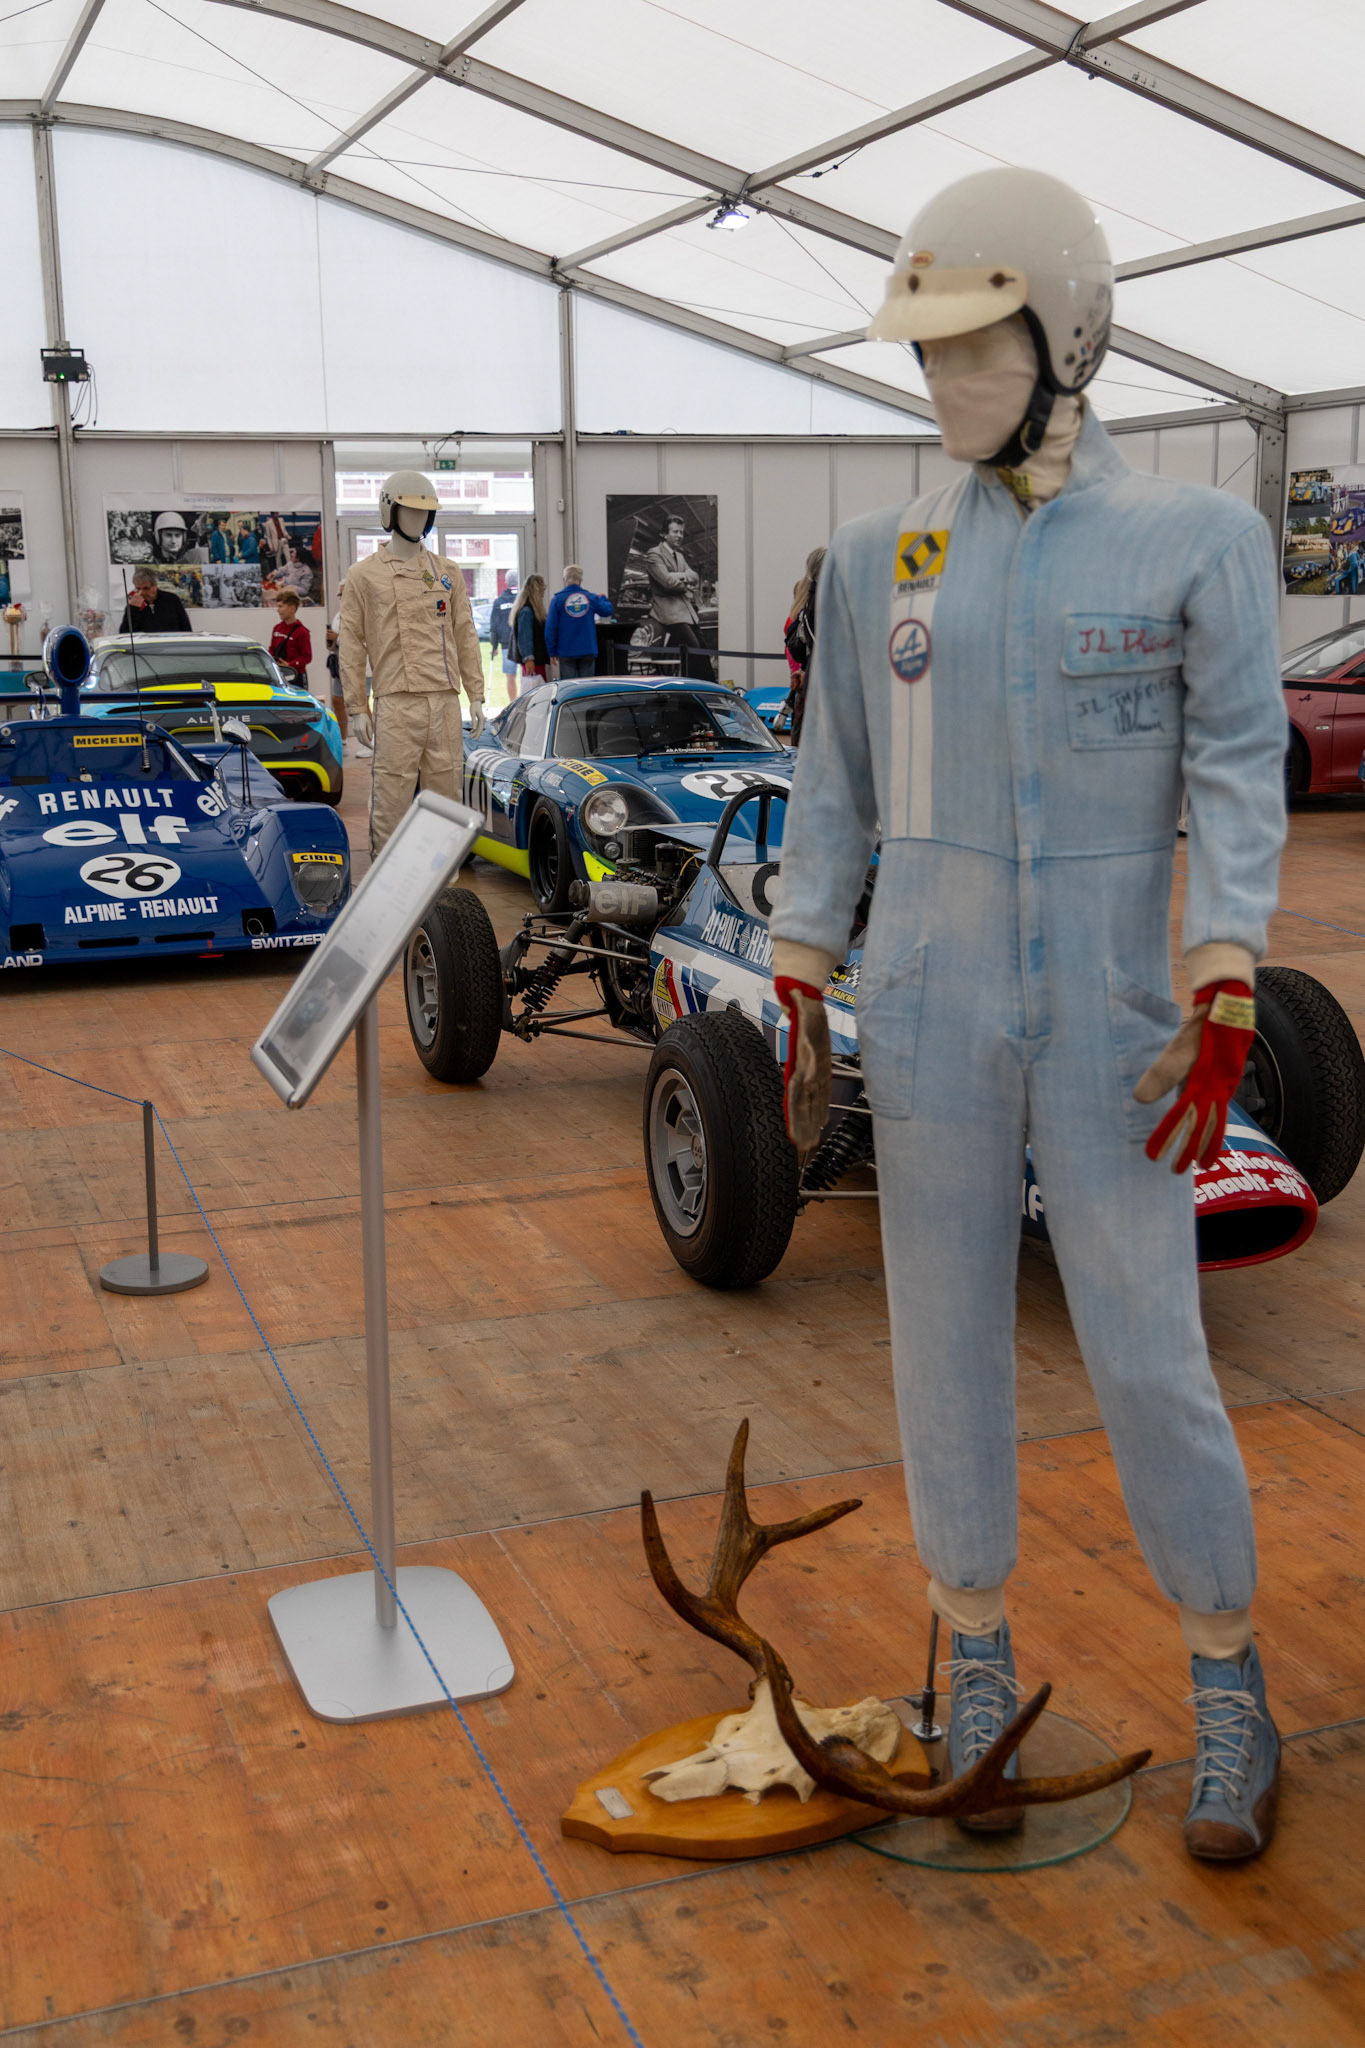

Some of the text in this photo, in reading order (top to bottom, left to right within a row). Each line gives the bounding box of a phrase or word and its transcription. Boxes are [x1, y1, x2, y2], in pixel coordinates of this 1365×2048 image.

[897, 578, 935, 593] RENAULT
[186, 715, 251, 724] ALPINE
[76, 736, 139, 746] MICHELIN
[196, 781, 229, 818] elf
[694, 772, 770, 799] 28
[38, 788, 174, 816] RENAULT
[42, 813, 191, 847] elf
[86, 856, 175, 892] 26
[64, 902, 127, 925] ALPINE
[139, 896, 219, 919] RENAULT
[594, 888, 649, 916] elf
[251, 933, 326, 950] SWITZER
[700, 909, 775, 968] ALPINE REN
[1194, 1170, 1306, 1205] enault-elf
